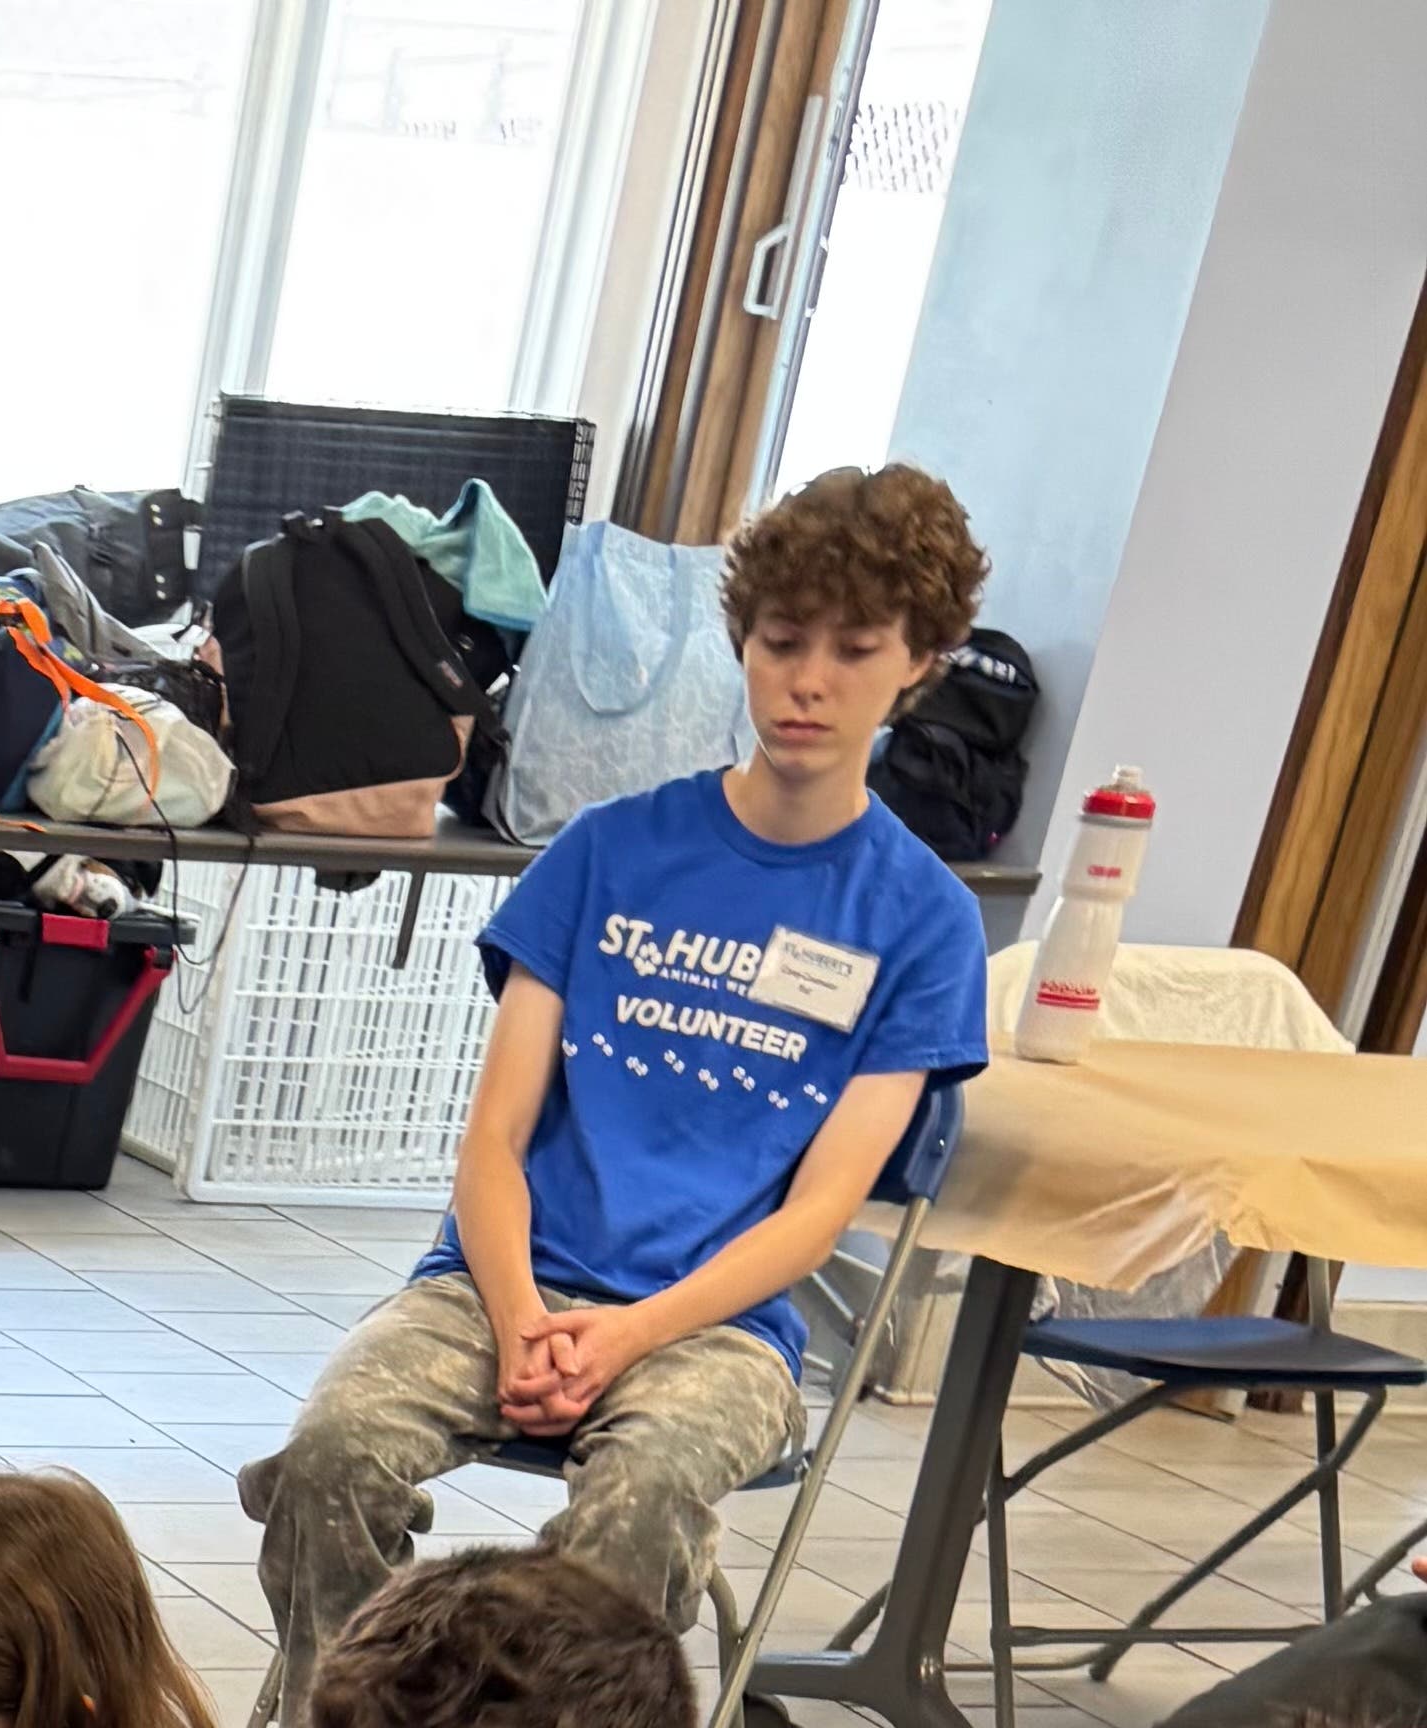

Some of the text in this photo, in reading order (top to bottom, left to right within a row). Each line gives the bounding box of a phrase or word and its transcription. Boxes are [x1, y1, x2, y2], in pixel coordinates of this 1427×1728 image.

[659, 966, 748, 996] ANIMAL WE
[665, 929, 762, 983] HUB
[616, 994, 808, 1063] VOLUNTEER
